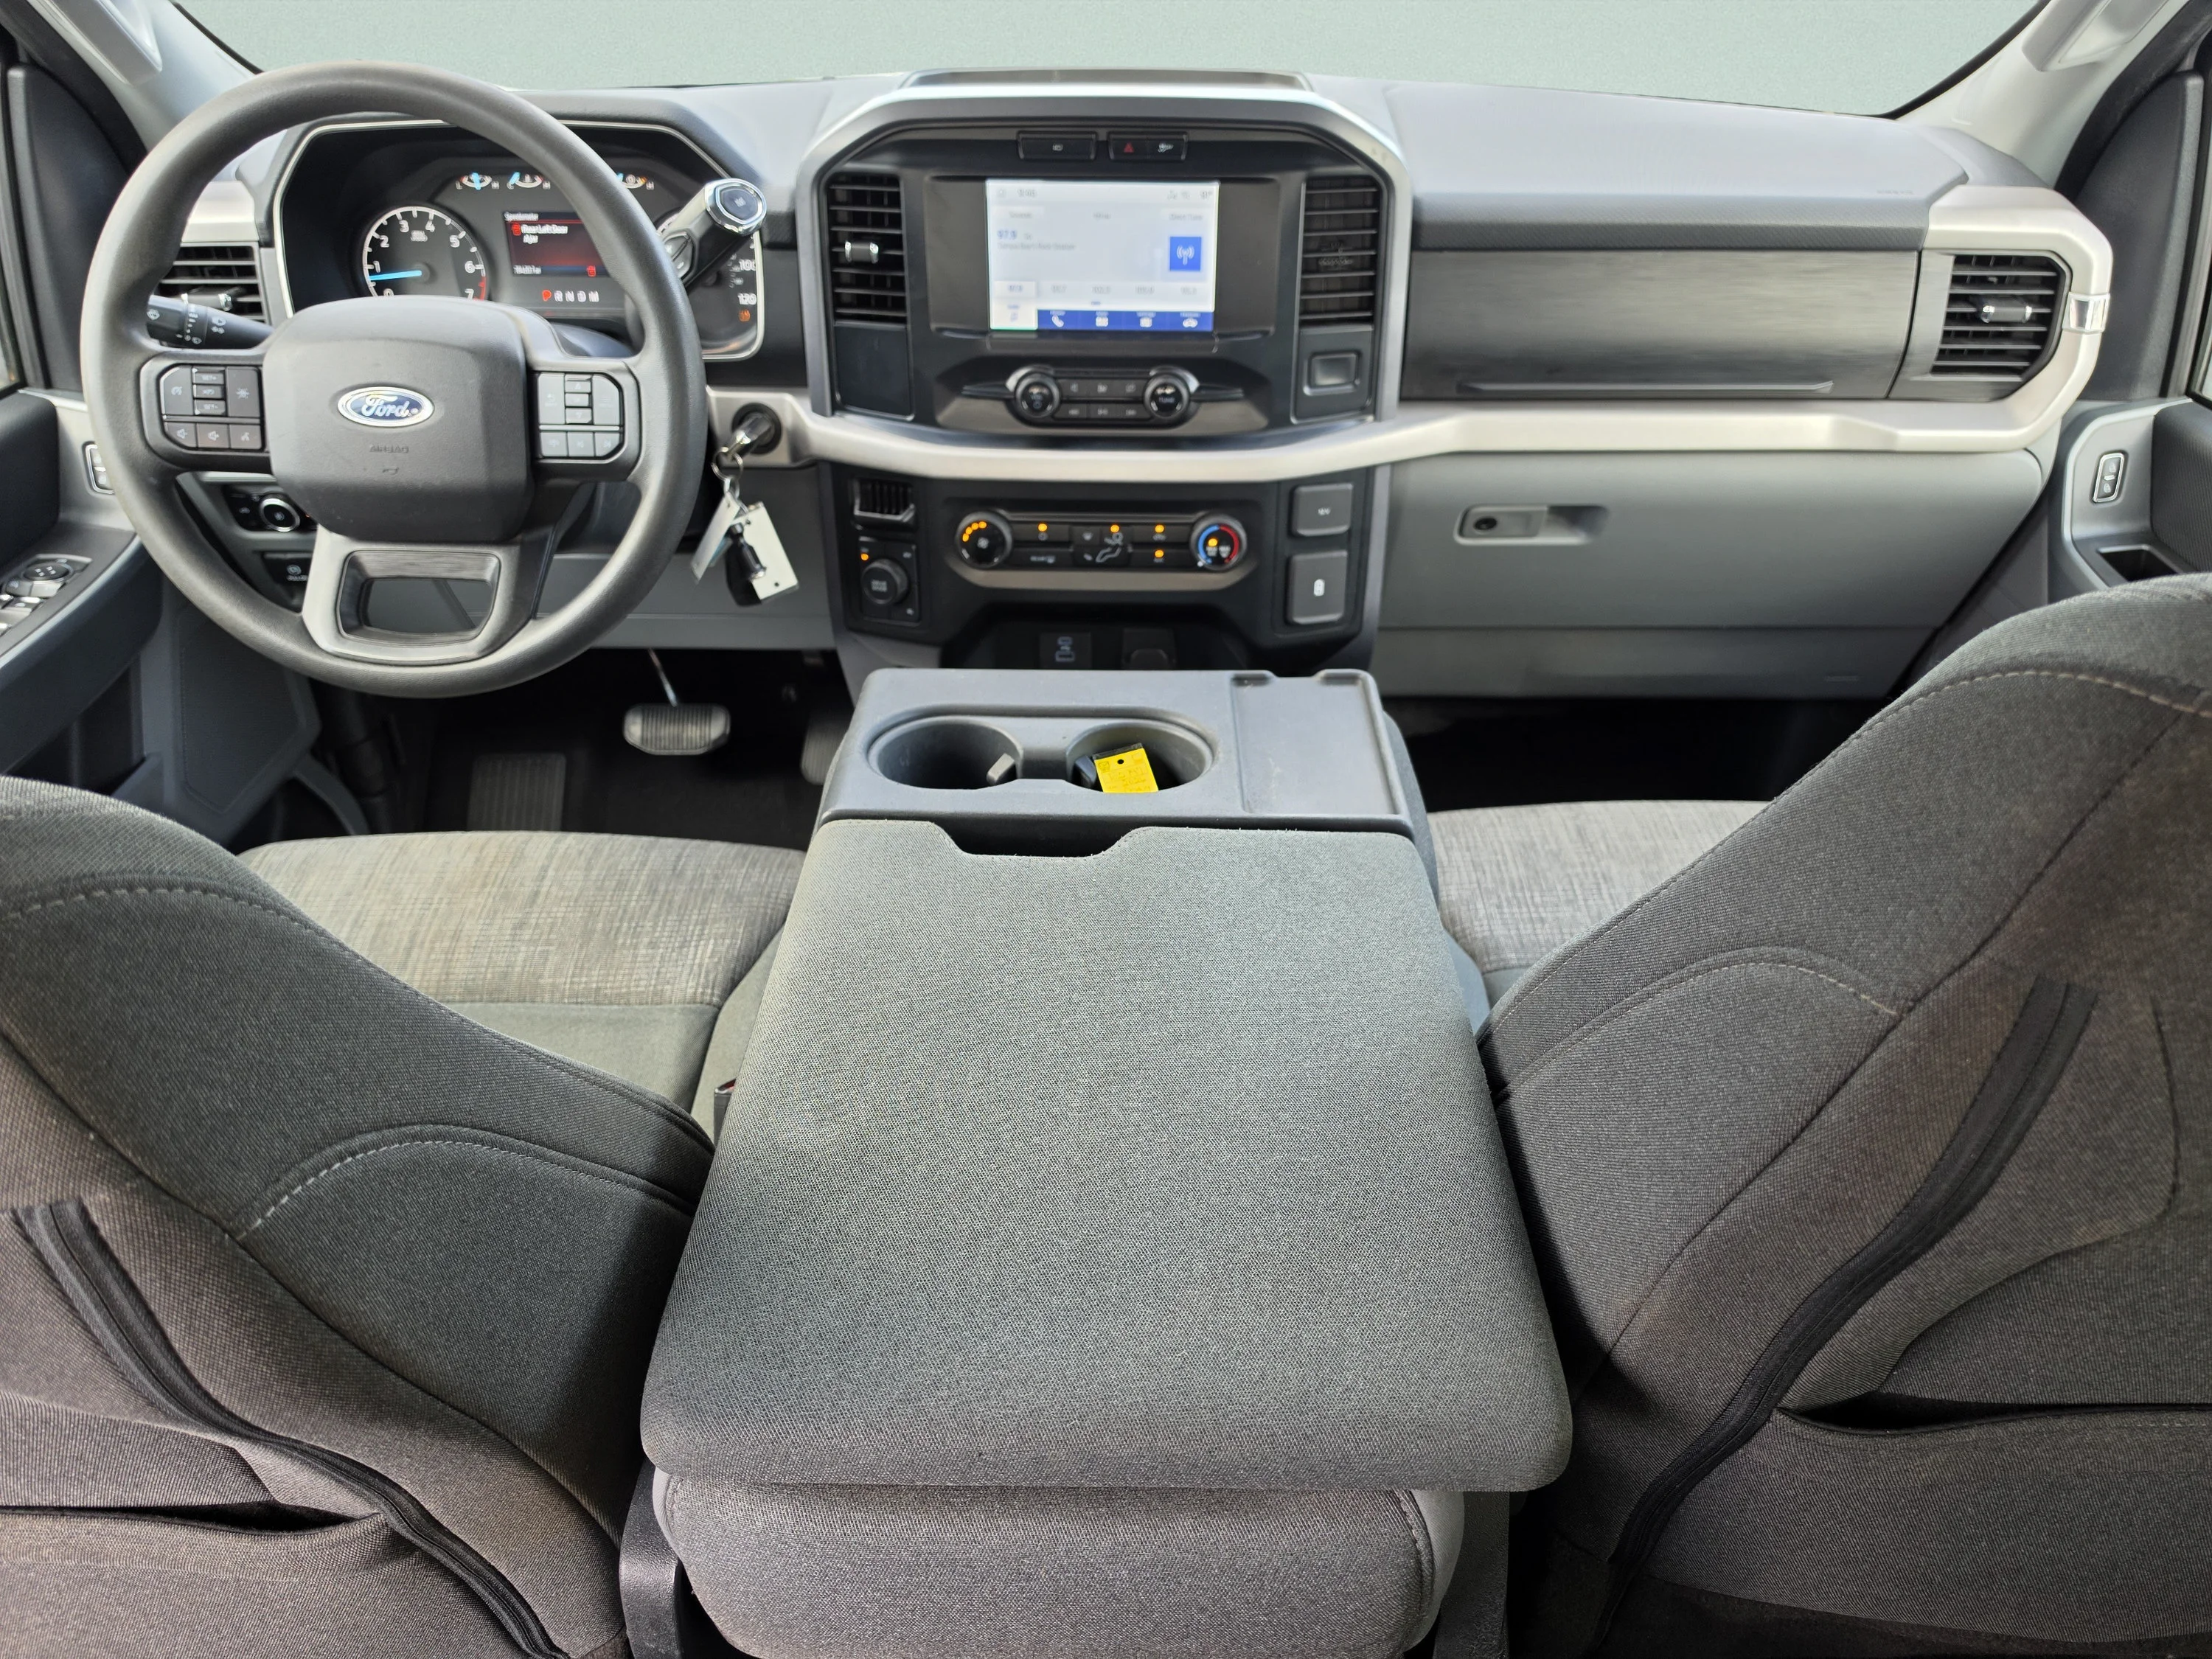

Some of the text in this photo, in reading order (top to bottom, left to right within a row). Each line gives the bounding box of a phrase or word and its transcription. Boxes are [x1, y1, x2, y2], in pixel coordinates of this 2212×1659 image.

[399, 220, 409, 232] 3
[425, 220, 435, 232] 4
[380, 235, 389, 248] 2
[449, 234, 460, 248] 5
[373, 260, 380, 273] 1
[465, 260, 476, 274] 6
[465, 288, 474, 299] 7
[542, 290, 599, 302] P R N D M
[738, 293, 757, 305] 120
[361, 394, 410, 417] Ford
